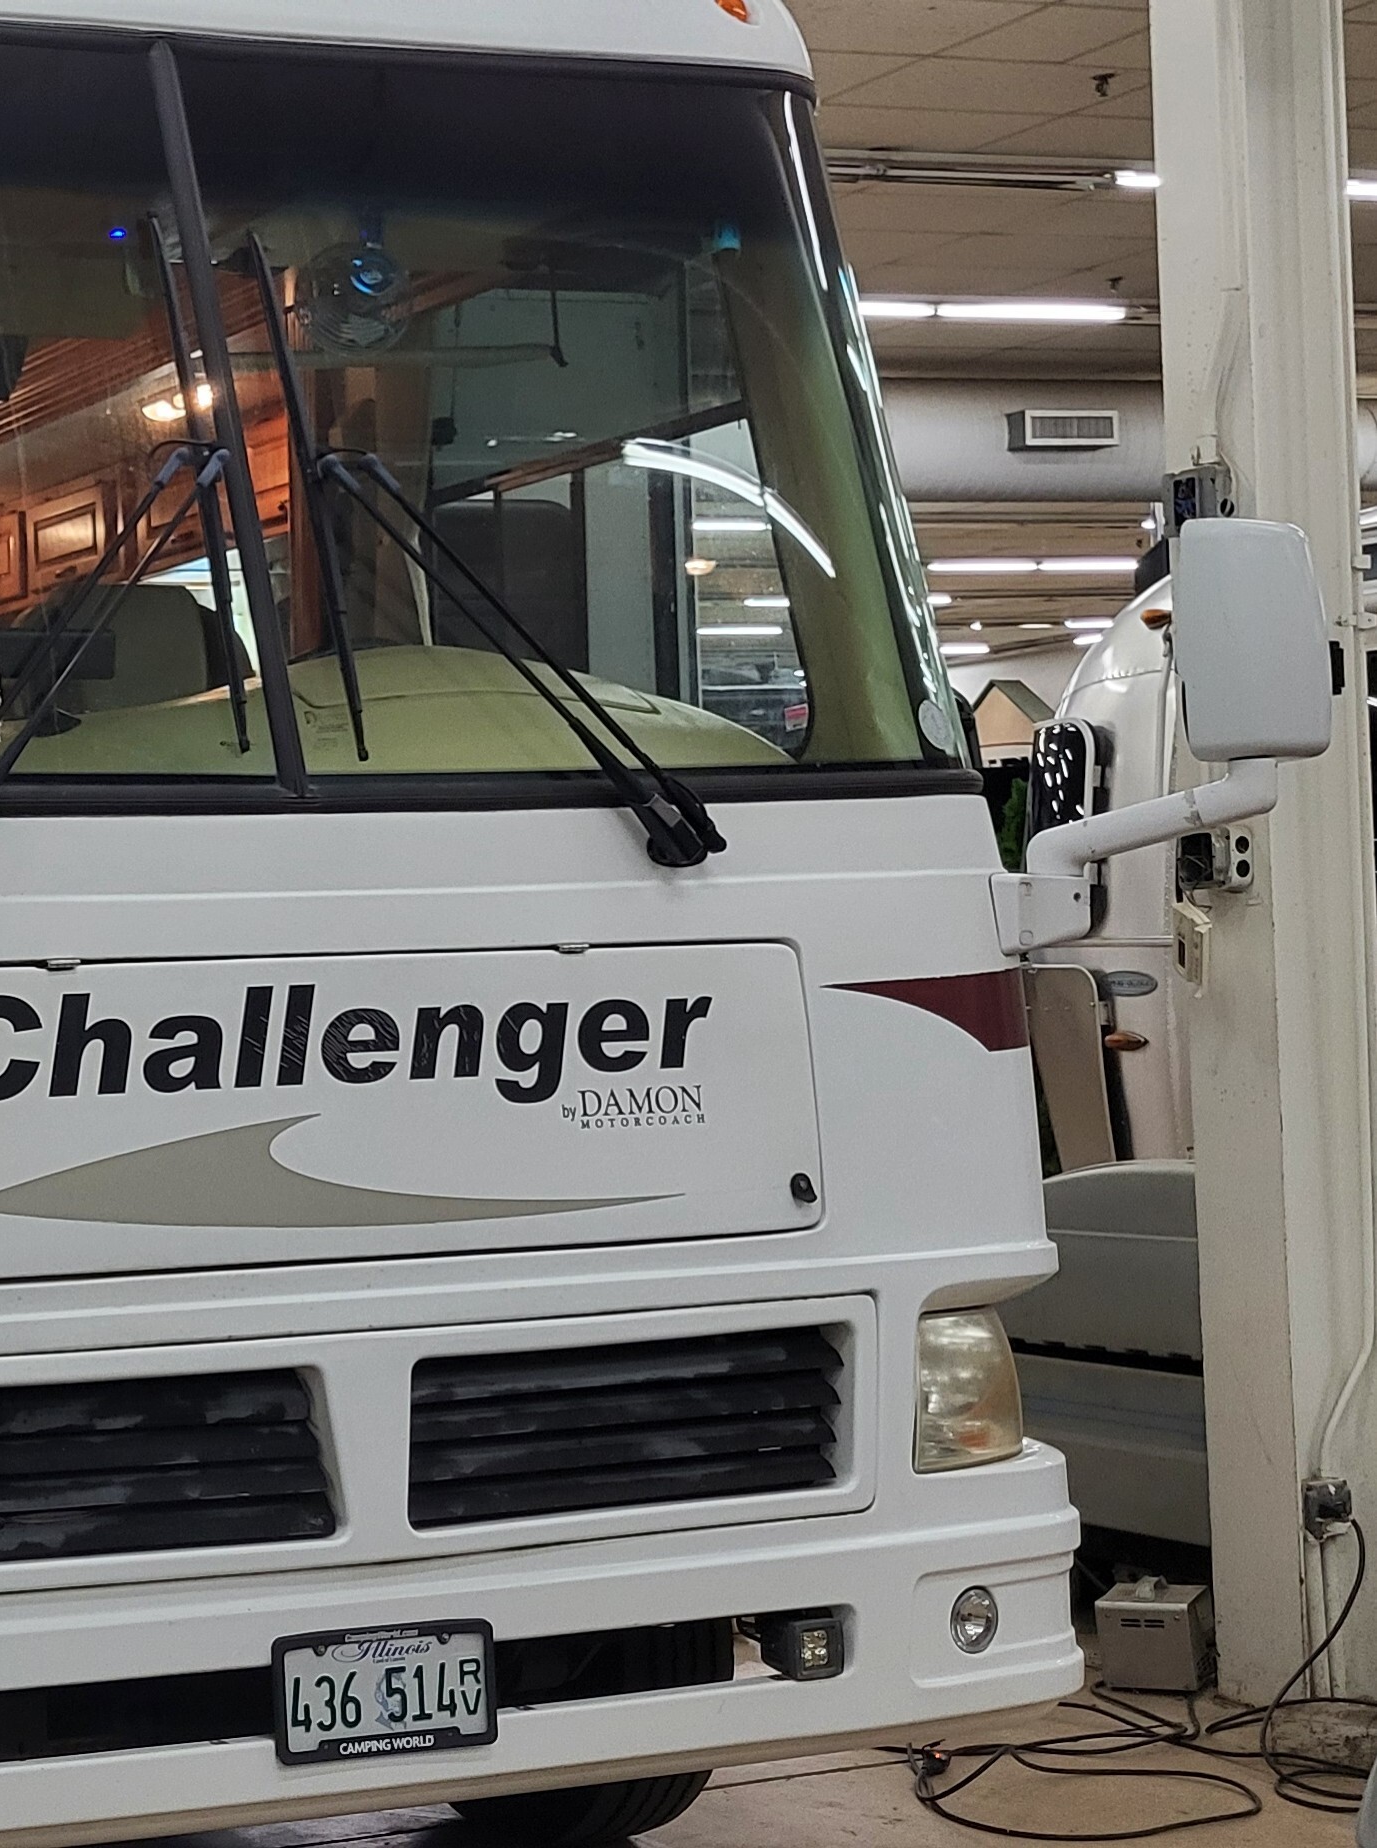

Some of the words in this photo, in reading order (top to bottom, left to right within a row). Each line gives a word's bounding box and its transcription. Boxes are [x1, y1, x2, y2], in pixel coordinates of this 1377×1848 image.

[561, 1104, 577, 1121] by
[577, 1085, 702, 1118] DAMON
[580, 1113, 706, 1129] MOTORCOACH
[331, 1640, 433, 1663] Illinois
[291, 1671, 361, 1732] 436
[385, 1662, 457, 1722] 514
[339, 1738, 392, 1755] CAMPING
[391, 1734, 435, 1750] WORLD
